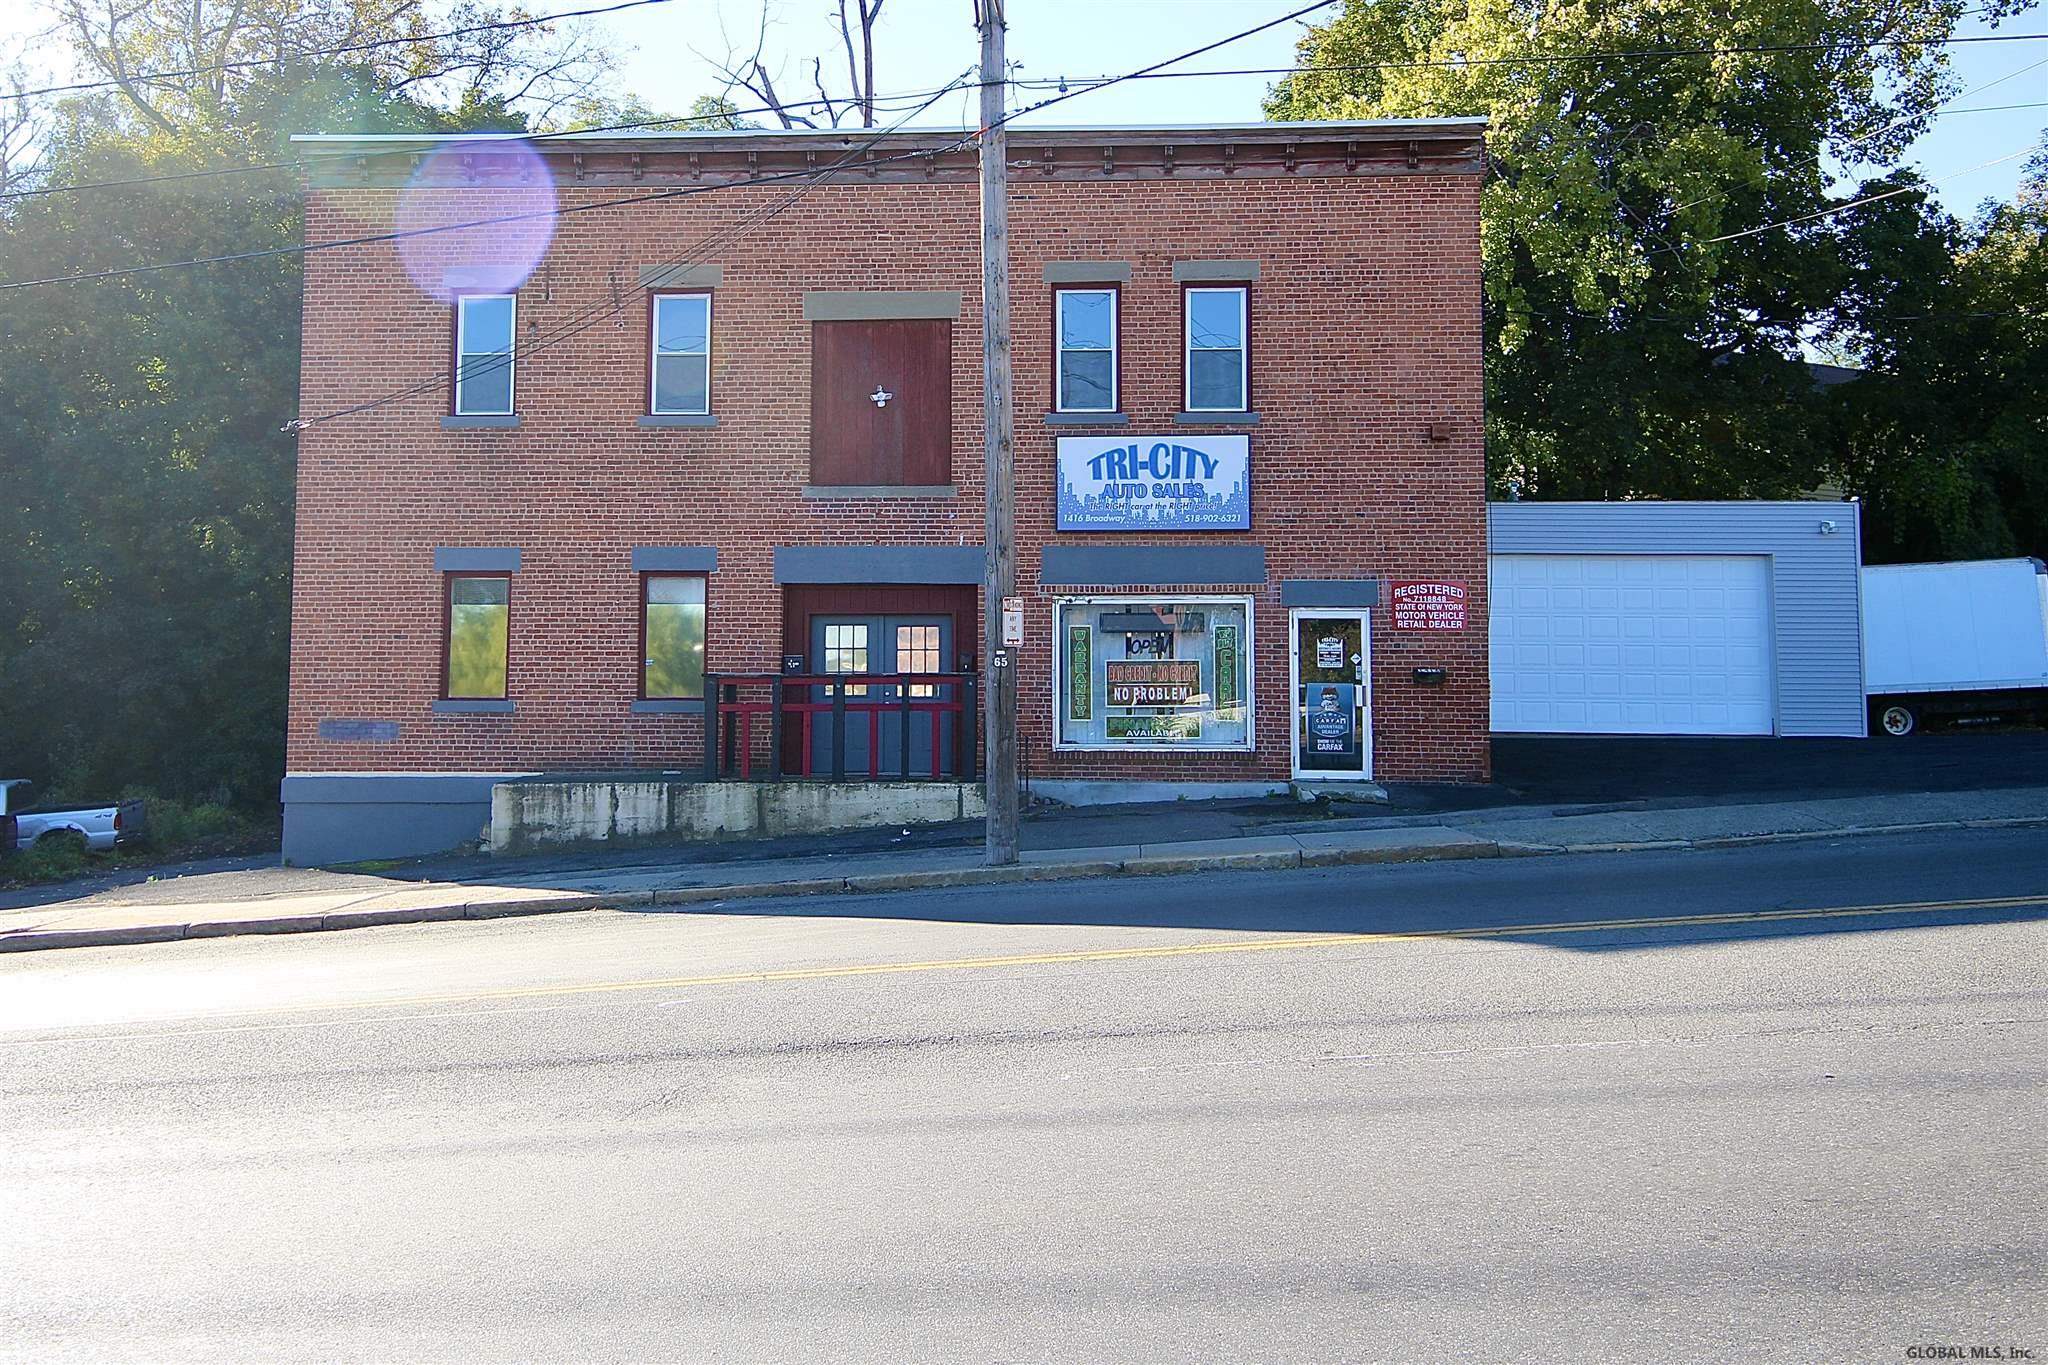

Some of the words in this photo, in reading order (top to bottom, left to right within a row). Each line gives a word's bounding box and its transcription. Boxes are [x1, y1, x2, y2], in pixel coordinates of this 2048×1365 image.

[1087, 443, 1219, 480] TRI-CITY
[1102, 482, 1148, 498] AUTO
[1151, 482, 1205, 498] SALES
[1105, 502, 1129, 510] RIGHT
[1144, 502, 1153, 510] at
[1155, 502, 1167, 510] the
[1169, 502, 1193, 510] RIGHT
[1063, 514, 1084, 522] 1416
[1085, 513, 1126, 524] Broadway
[1184, 514, 1241, 522] 518-902-6321
[1394, 584, 1464, 599] REGISTERED
[1395, 603, 1417, 611] STATE
[1426, 603, 1443, 611] NEW
[1443, 603, 1464, 611] YORK
[1395, 611, 1427, 620] MOTOR
[1428, 611, 1465, 620] VEHICLE
[1397, 620, 1427, 629] RETAIL
[1428, 620, 1463, 629] DEALER
[1131, 639, 1170, 655] OPEN
[994, 657, 1008, 667] 65
[1108, 665, 1124, 682] BAD
[1124, 665, 1152, 682] CREDIT
[1169, 664, 1198, 681] CREDIT
[1114, 687, 1129, 700] NO
[1317, 743, 1344, 751] CARFAX
